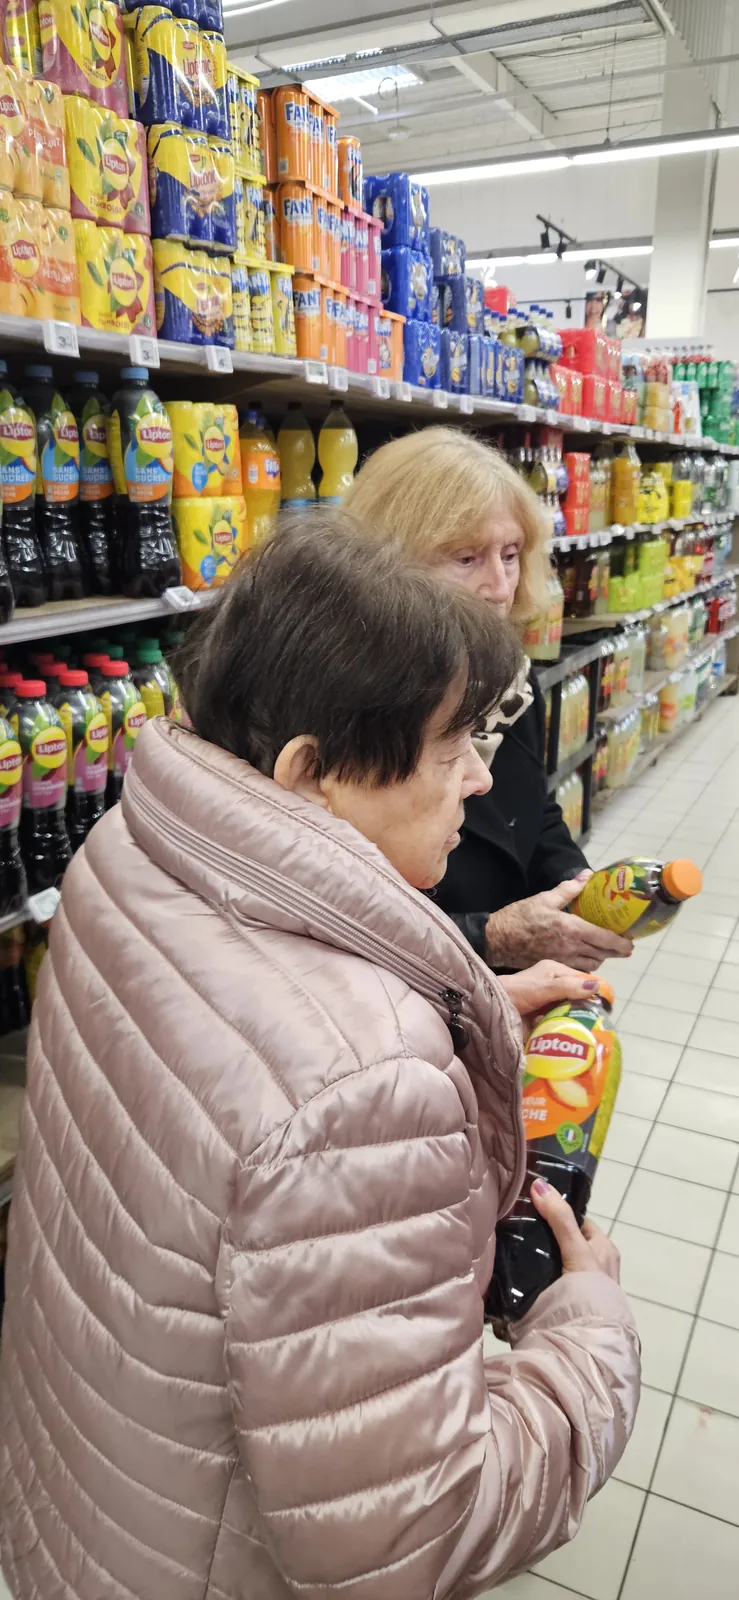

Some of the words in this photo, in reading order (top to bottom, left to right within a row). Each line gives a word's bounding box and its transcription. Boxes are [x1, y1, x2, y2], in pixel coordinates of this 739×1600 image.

[105, 154, 126, 171] Lipton
[12, 244, 34, 257] Lipton
[142, 428, 172, 441] Lipton
[206, 440, 223, 450] Lipton
[214, 533, 232, 543] Lipton
[616, 867, 626, 891] Lipton
[530, 1036, 584, 1057] Lipton
